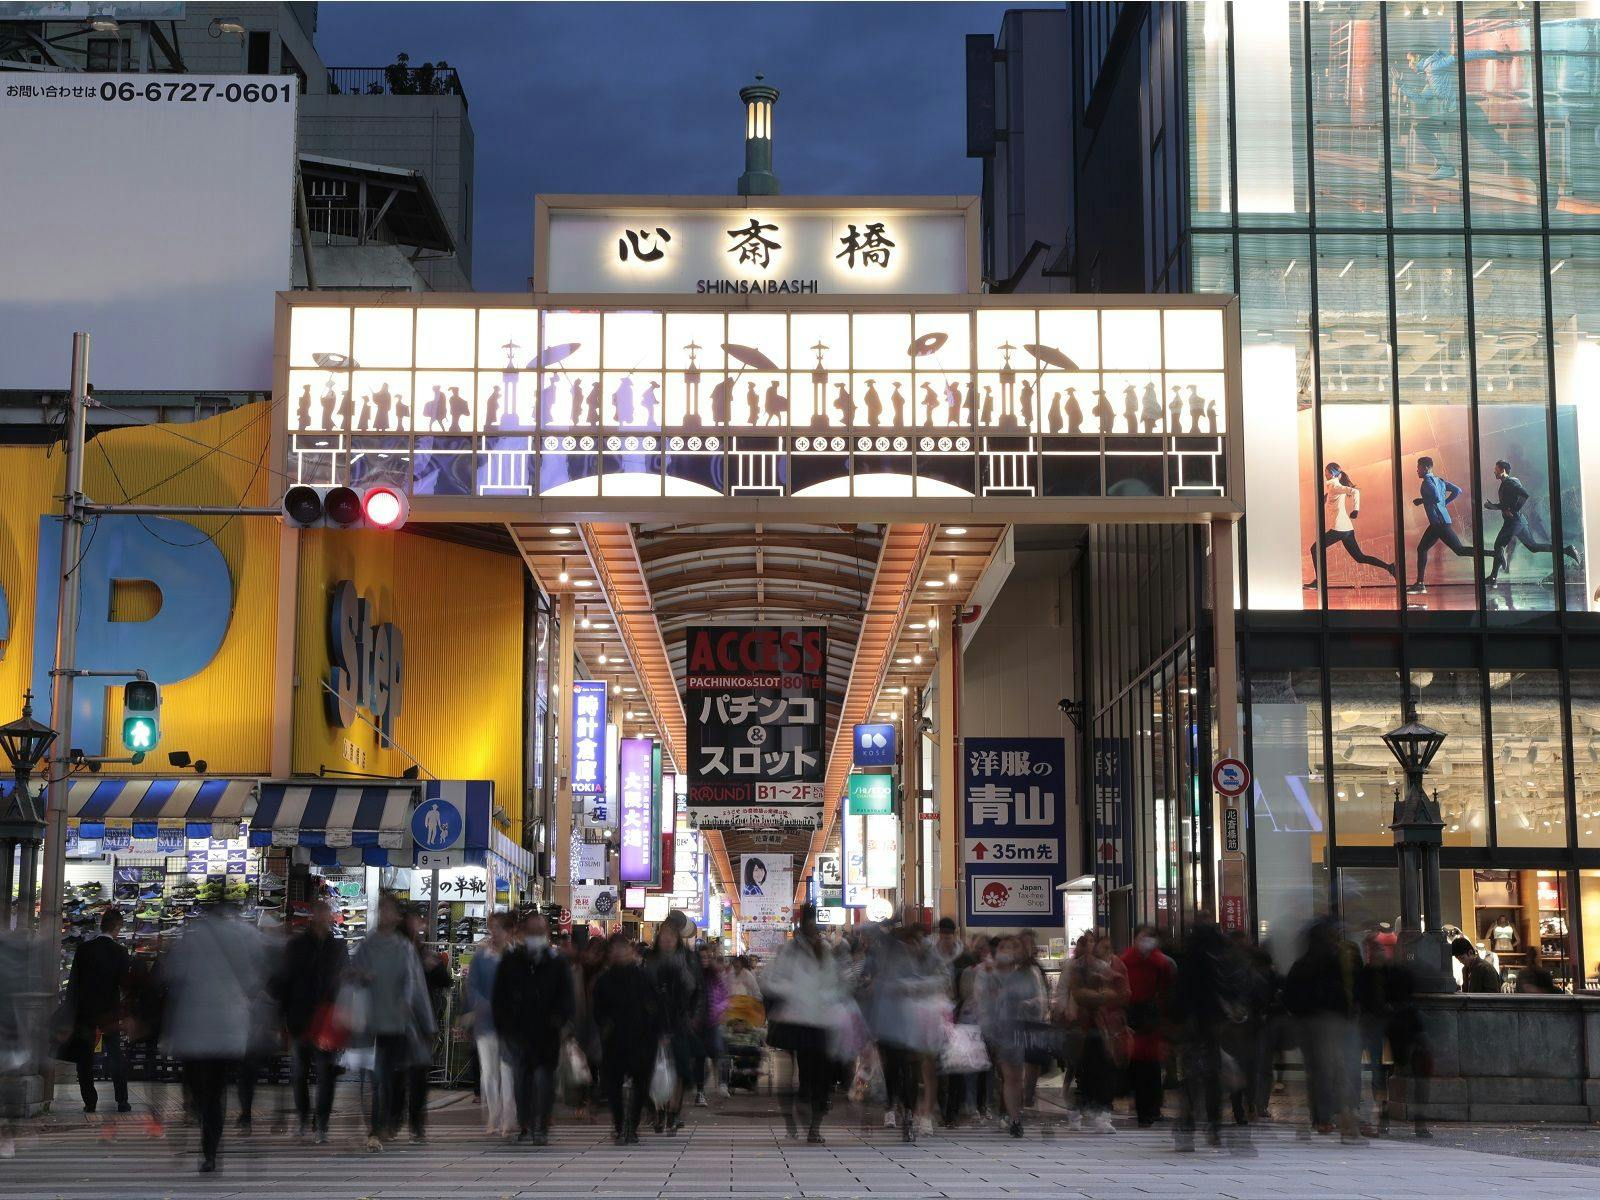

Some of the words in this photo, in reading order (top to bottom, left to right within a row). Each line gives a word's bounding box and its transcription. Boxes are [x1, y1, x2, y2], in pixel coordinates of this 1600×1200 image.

[6, 85, 97, 98] お問い合わせは
[100, 81, 291, 103] 06-6727-0601
[696, 279, 818, 294] SHINSAIBASHI
[689, 630, 823, 672] ACCESS
[331, 580, 403, 749] Step
[689, 677, 781, 687] PACHINKO&SLOT
[699, 694, 815, 725] パチンコ
[699, 745, 817, 776] スロット
[969, 750, 1053, 777] 洋服の
[572, 784, 602, 792] TOKIA
[690, 783, 752, 801] ROUND1
[967, 783, 1055, 826] 青山
[105, 837, 130, 847] SALE
[158, 837, 183, 847] SALE
[992, 843, 1053, 860] 35m先
[1019, 884, 1044, 892] Japan.
[1027, 900, 1045, 908] Shop
